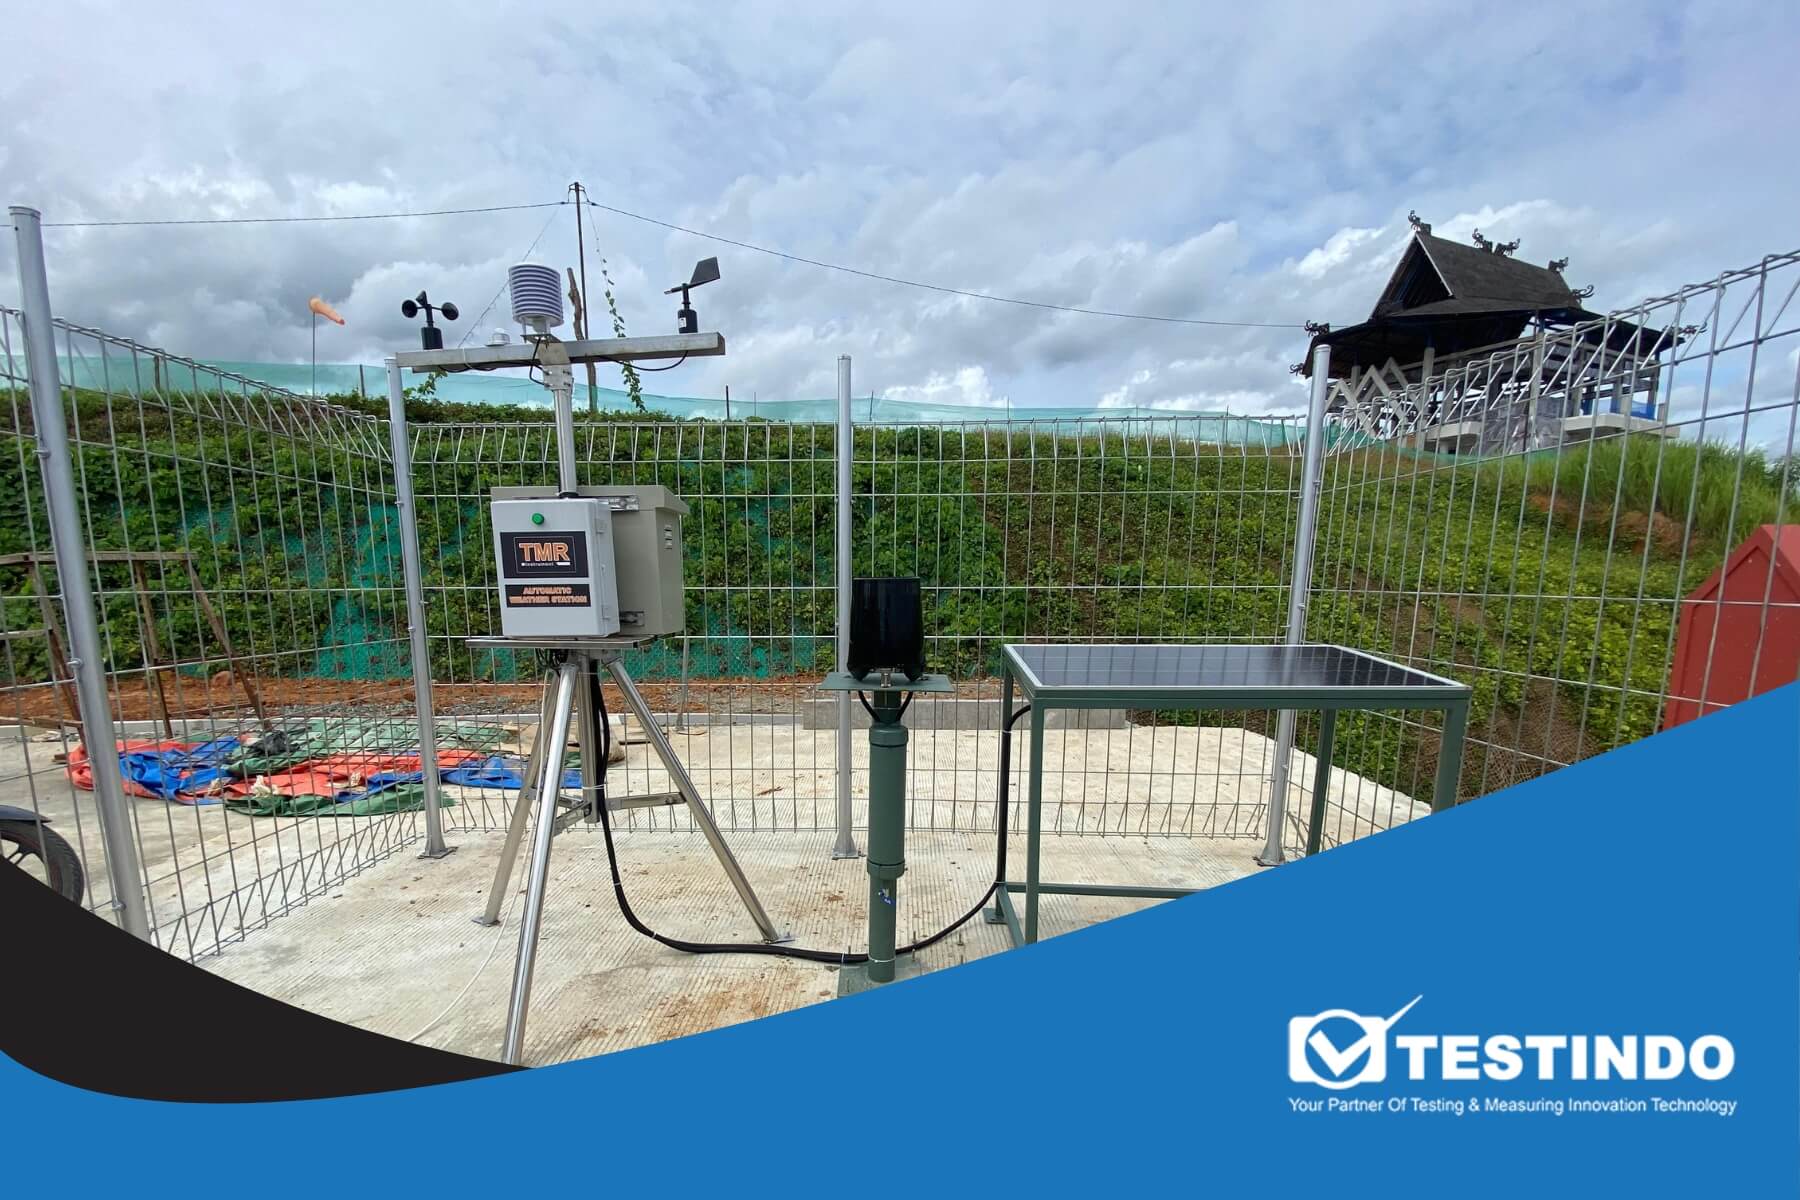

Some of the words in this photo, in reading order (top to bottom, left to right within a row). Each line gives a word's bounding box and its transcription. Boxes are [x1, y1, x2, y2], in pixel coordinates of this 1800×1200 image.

[518, 542, 570, 562] TMR
[523, 587, 572, 595] AUTOMATIC
[509, 595, 550, 604] WEATHER
[551, 595, 588, 603] STATION
